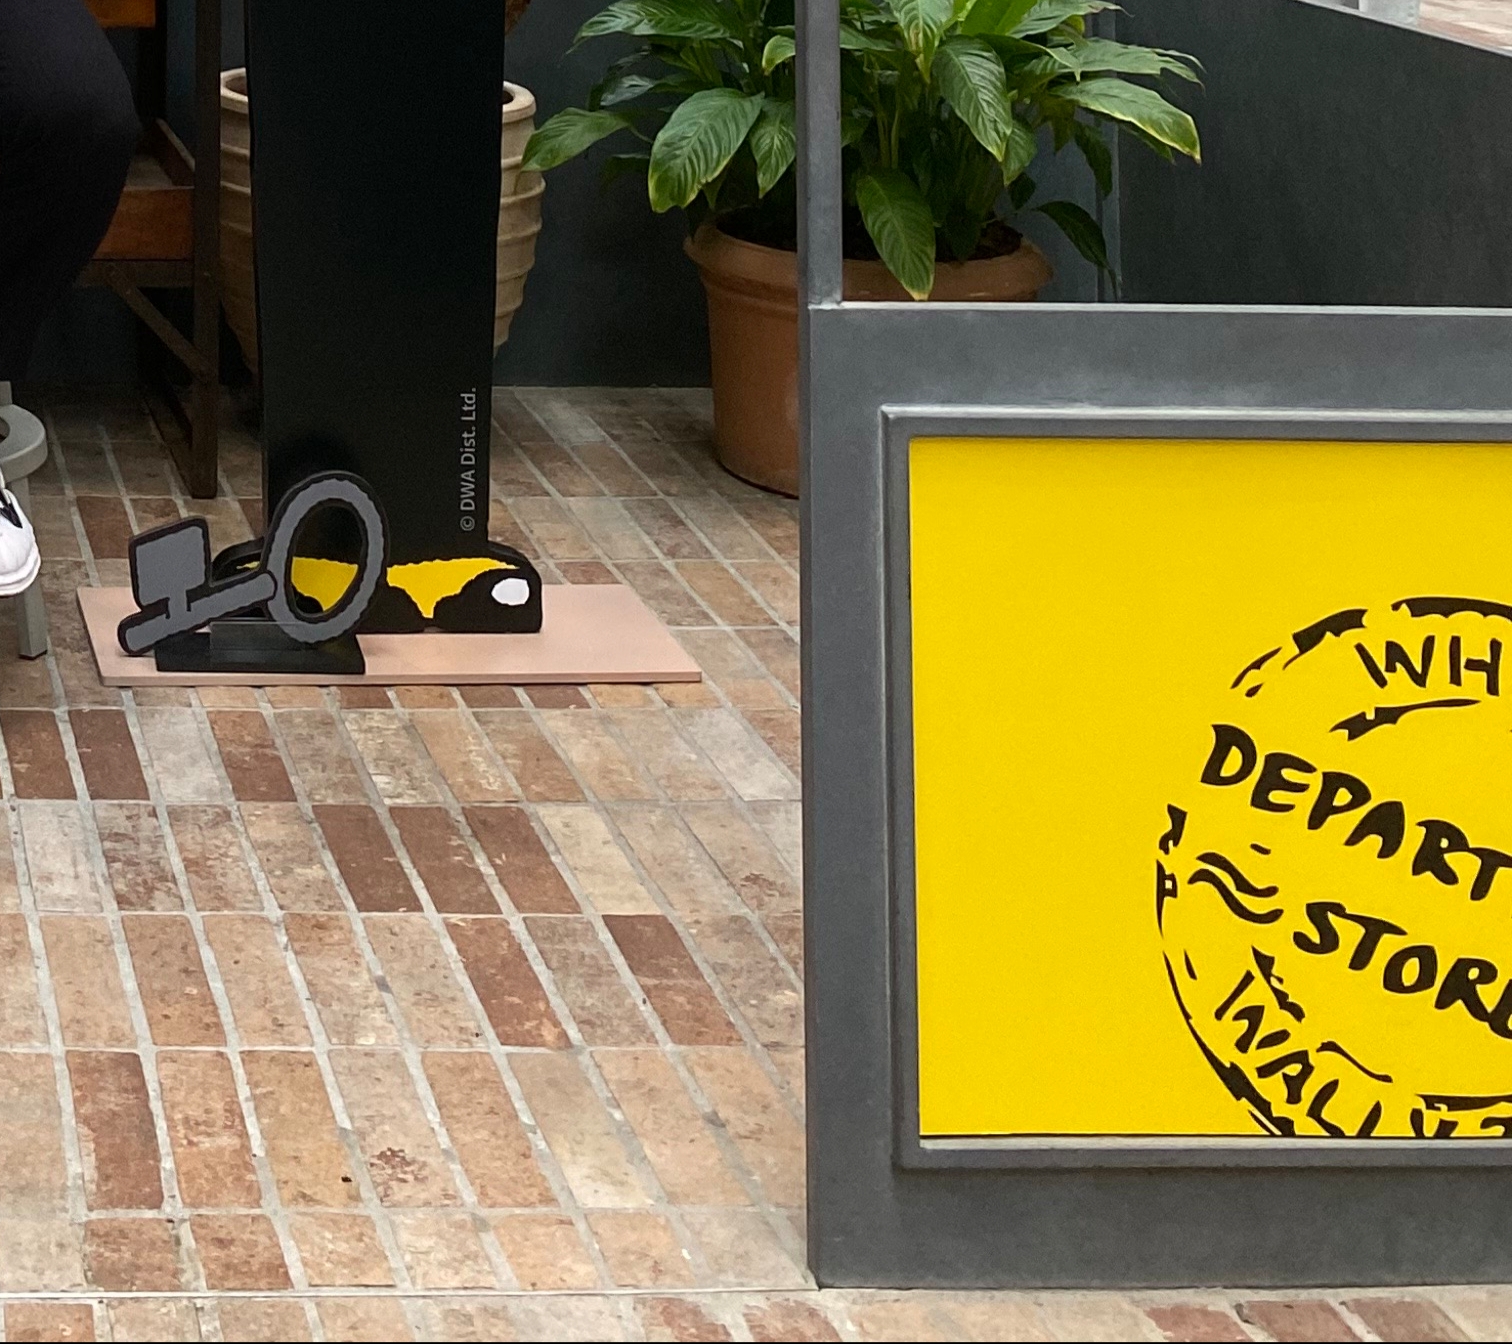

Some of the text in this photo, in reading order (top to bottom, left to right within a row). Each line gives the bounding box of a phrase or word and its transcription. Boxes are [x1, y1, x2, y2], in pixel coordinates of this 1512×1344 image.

[459, 387, 477, 421] Ltd.
[459, 426, 476, 466] Dist.
[459, 469, 476, 511] DWA
[1199, 723, 1512, 901] DEPART
